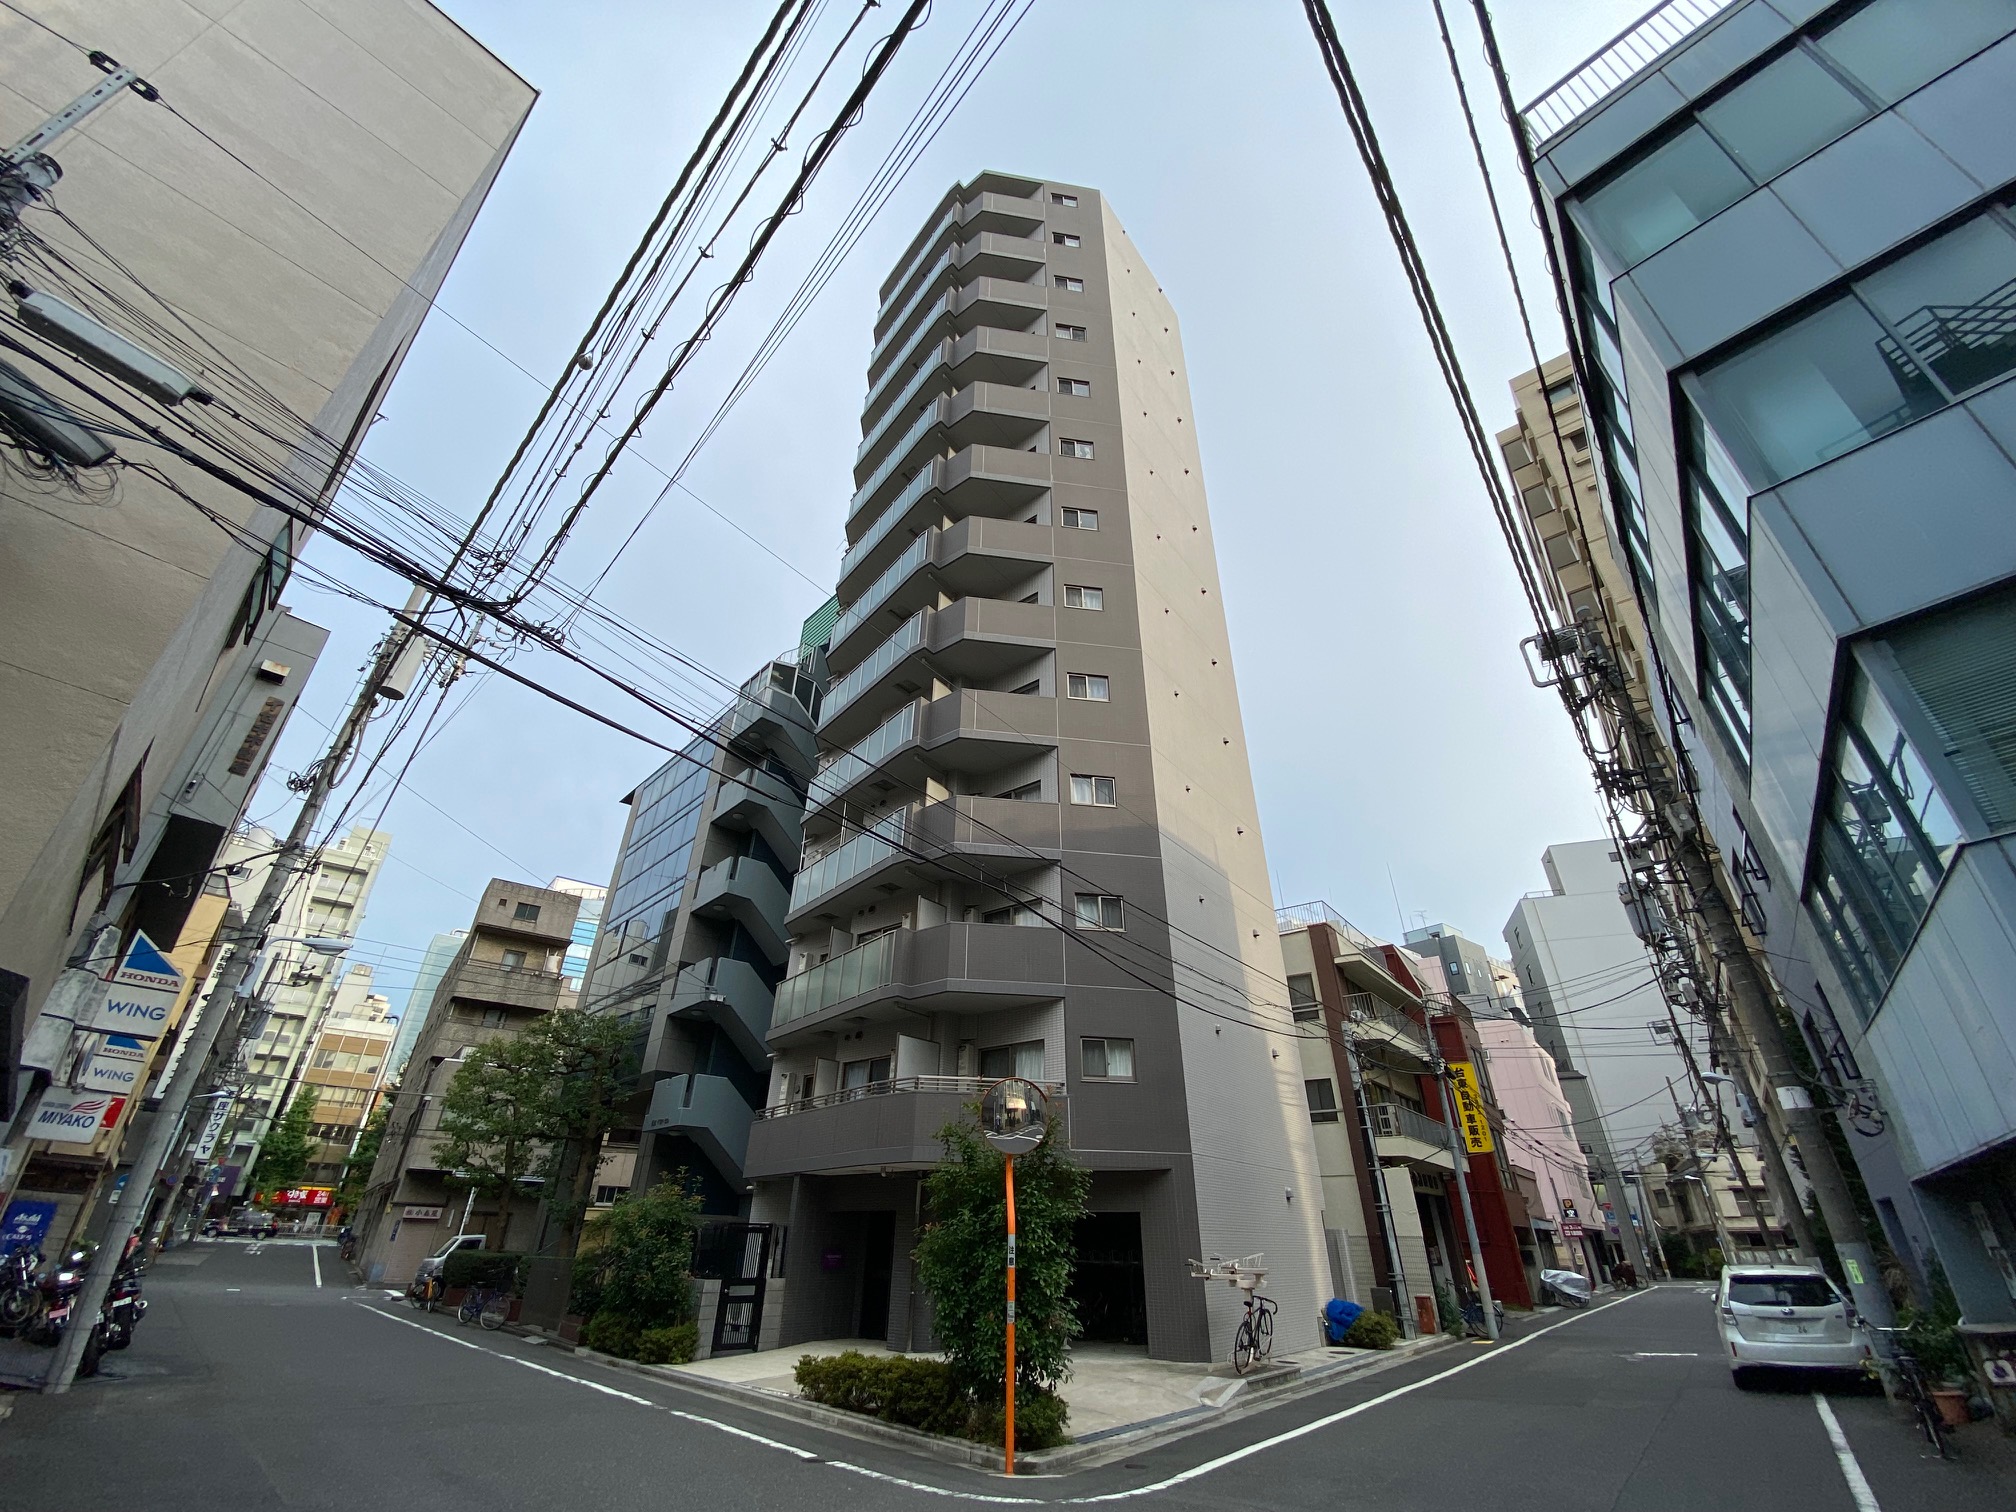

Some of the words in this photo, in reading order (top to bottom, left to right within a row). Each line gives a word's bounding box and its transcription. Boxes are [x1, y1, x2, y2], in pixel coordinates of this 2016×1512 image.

[120, 971, 180, 988] HONDA
[108, 999, 166, 1021] WING
[102, 1047, 145, 1058] HONDA
[94, 1067, 135, 1083] WING
[1454, 1067, 1483, 1148] 台東自動車販売
[38, 1110, 95, 1129] MIYAKO
